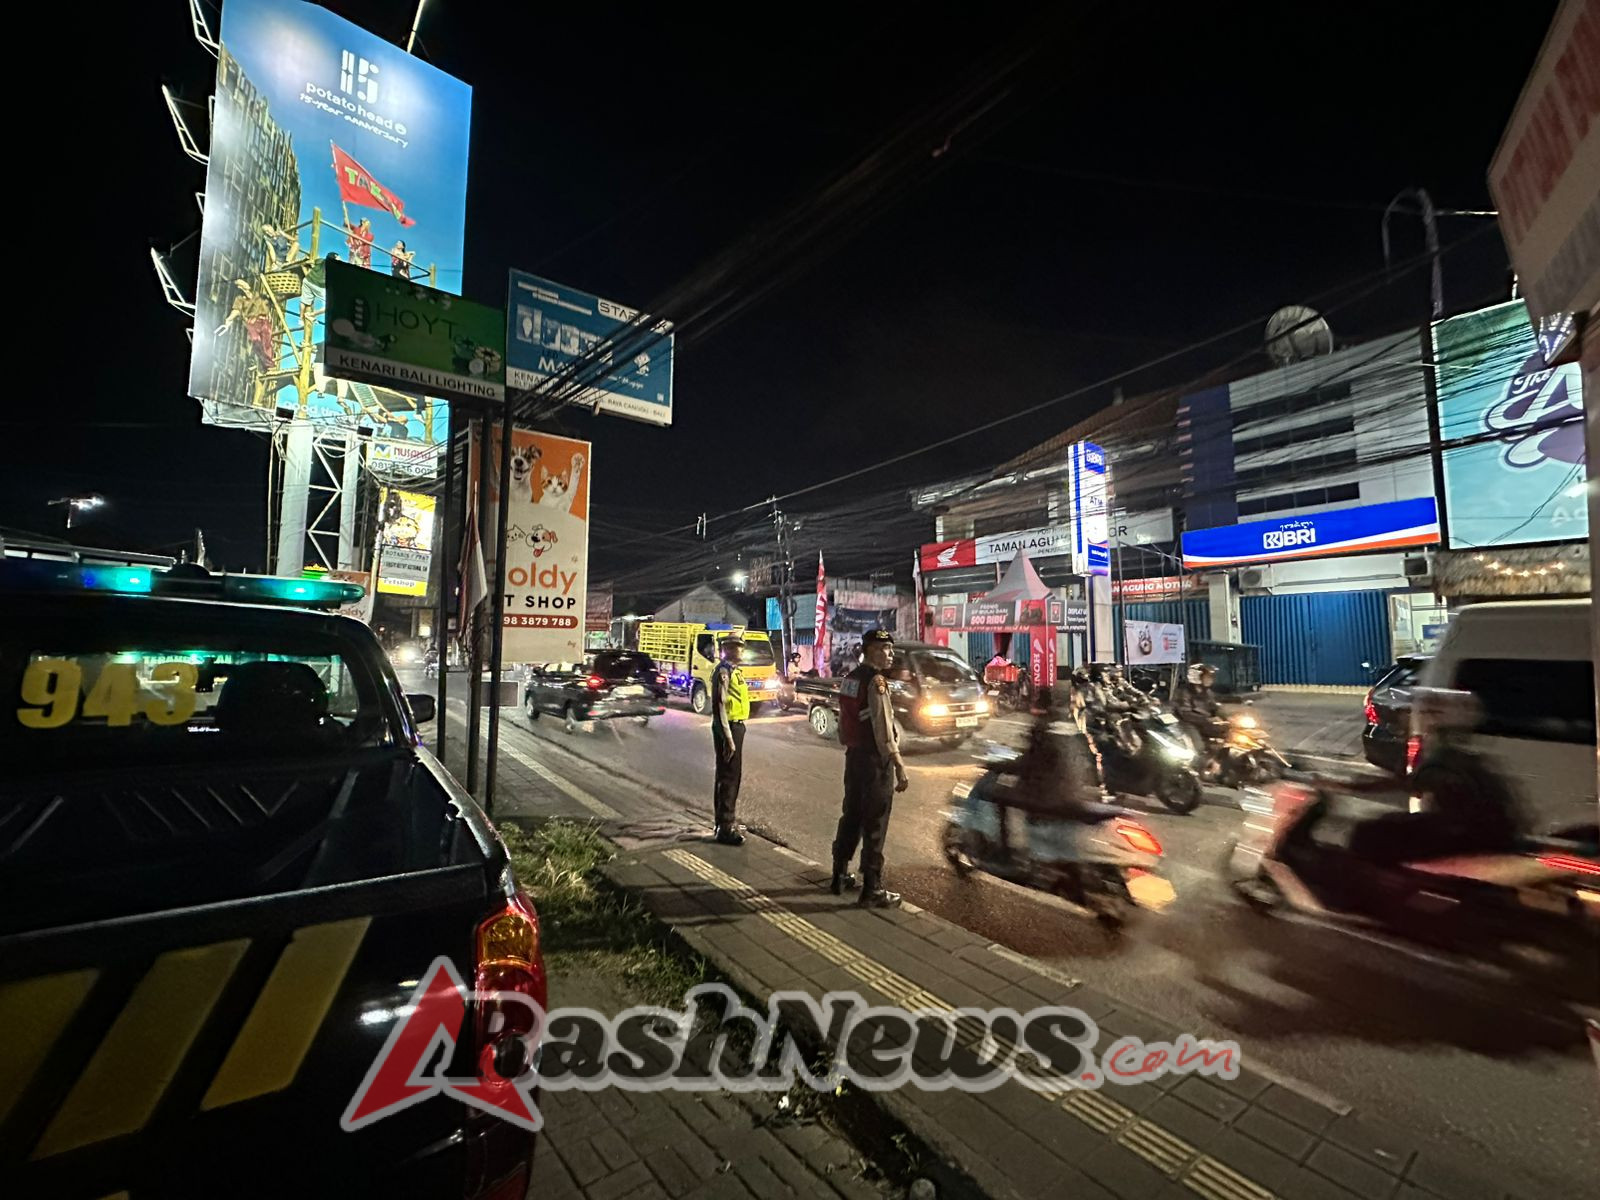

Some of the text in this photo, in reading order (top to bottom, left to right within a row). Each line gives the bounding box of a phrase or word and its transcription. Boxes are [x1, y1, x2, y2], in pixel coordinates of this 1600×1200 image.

[344, 114, 409, 149] anniversary
[339, 355, 396, 377] KENARI
[400, 368, 433, 385] BALI
[435, 377, 496, 398] LIGHTING
[1512, 371, 1550, 394] The
[989, 540, 1026, 554] TAMAN
[1283, 528, 1317, 546] BRI
[508, 562, 577, 595] oldy
[525, 595, 576, 609] SHOP
[503, 616, 571, 626] 98 3879 788
[17, 659, 198, 728] 943
